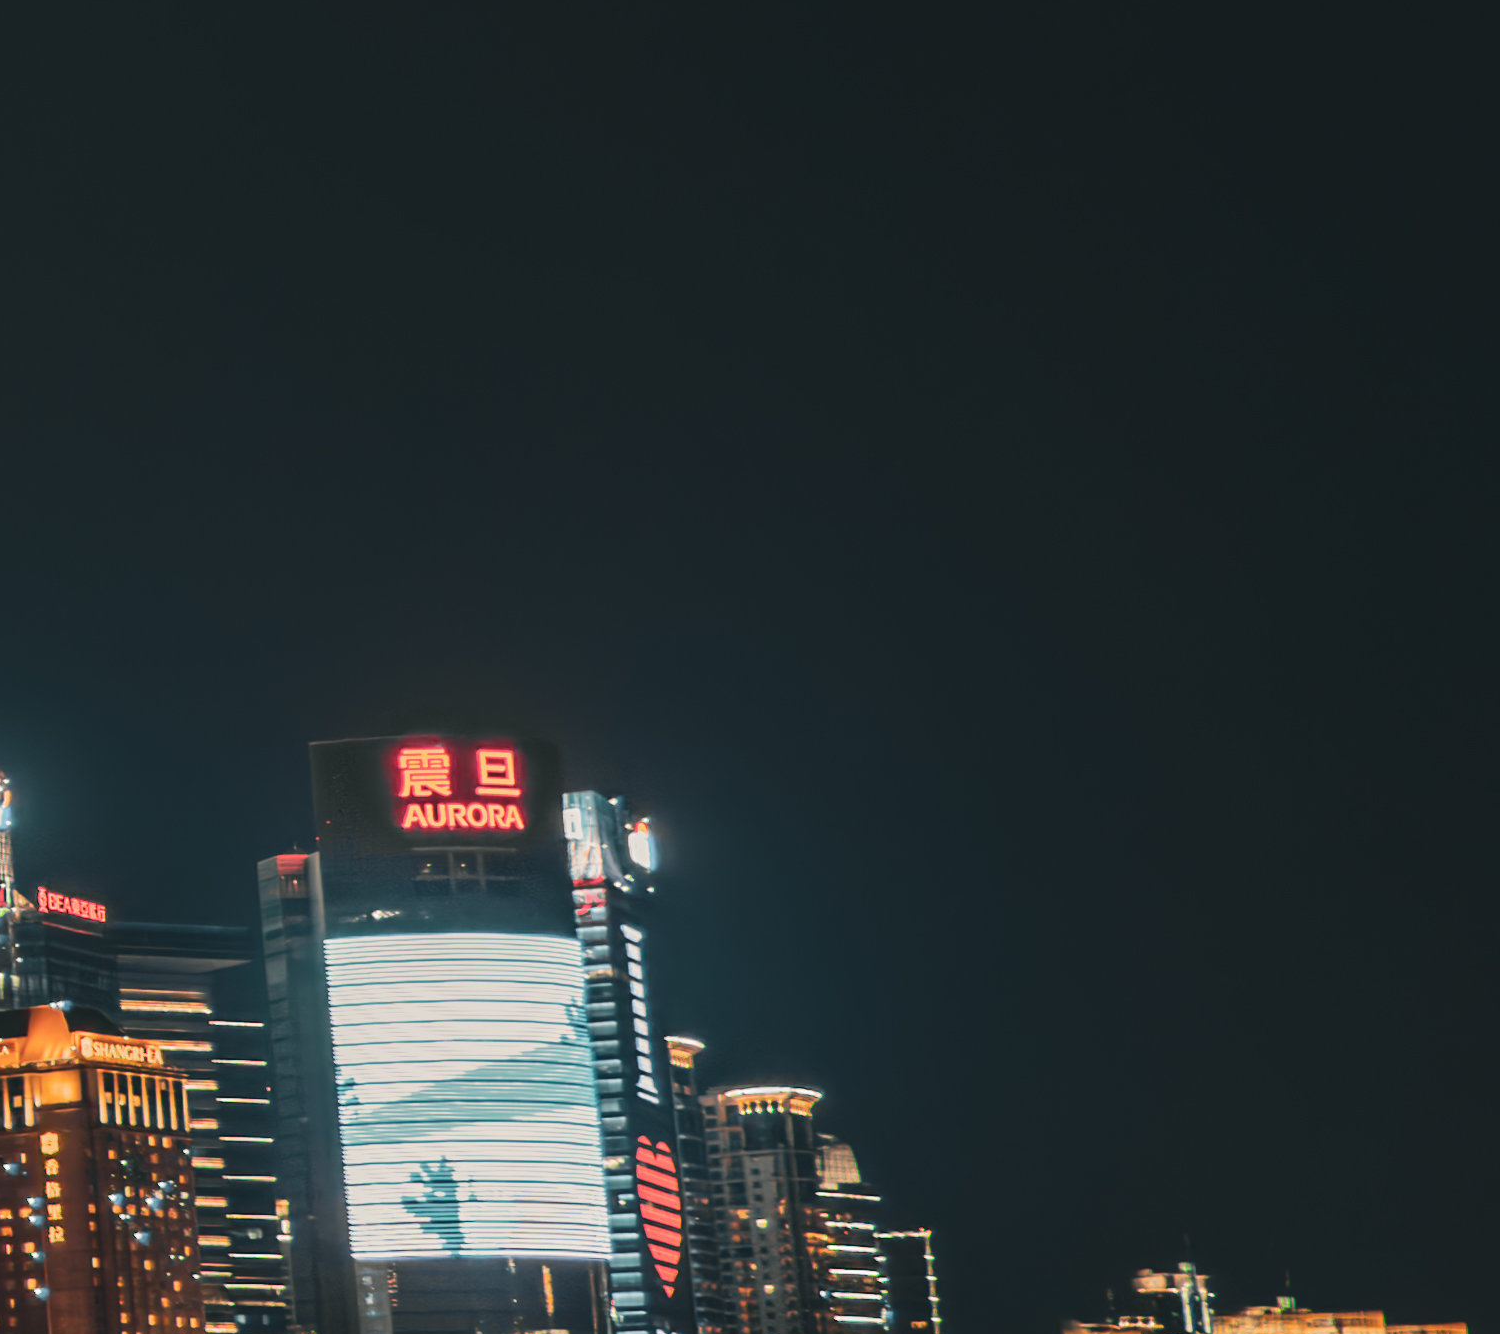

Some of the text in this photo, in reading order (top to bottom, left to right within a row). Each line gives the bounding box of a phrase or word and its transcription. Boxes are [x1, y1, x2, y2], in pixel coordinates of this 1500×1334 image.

[398, 748, 521, 798] 震旦
[401, 802, 525, 830] AURORA
[93, 1040, 164, 1066] SHANGRI-LA
[44, 1158, 66, 1244] 香格里拉
